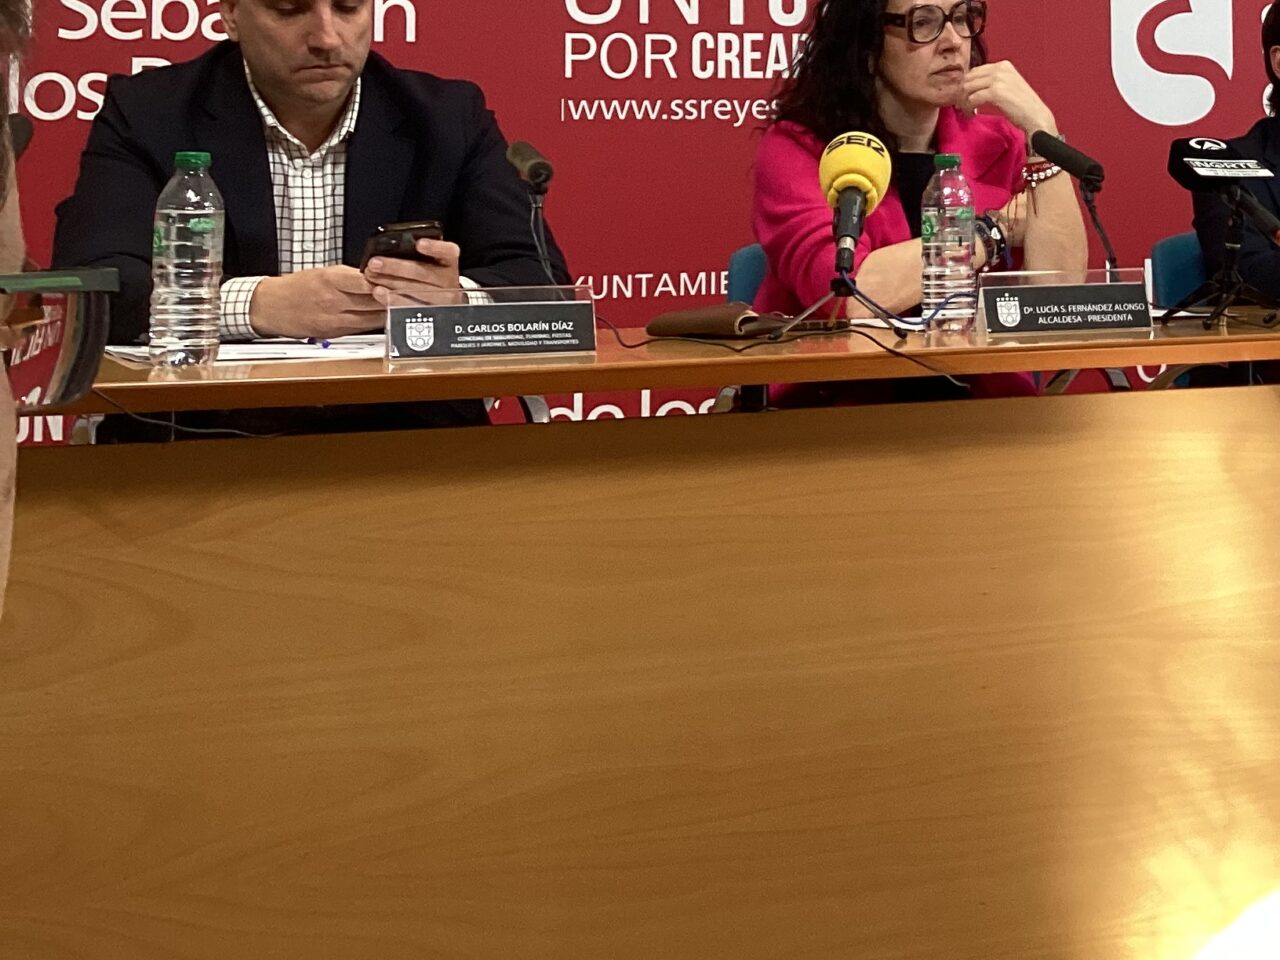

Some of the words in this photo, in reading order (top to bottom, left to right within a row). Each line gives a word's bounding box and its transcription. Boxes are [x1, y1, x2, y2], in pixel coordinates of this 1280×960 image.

[564, 31, 678, 80] POR
[826, 134, 886, 157] SER
[1036, 304, 1059, 314] LUCÍA
[1068, 302, 1112, 312] FERNÁNDEZ
[1114, 302, 1145, 311] ALONSO
[1038, 315, 1082, 324] ALCALDESA
[1087, 313, 1133, 323] PRESIDENTA
[454, 325, 465, 334] D.
[467, 323, 506, 334] CARLOS
[507, 320, 549, 332] BOLARÍN
[551, 320, 574, 331] DÍAZ
